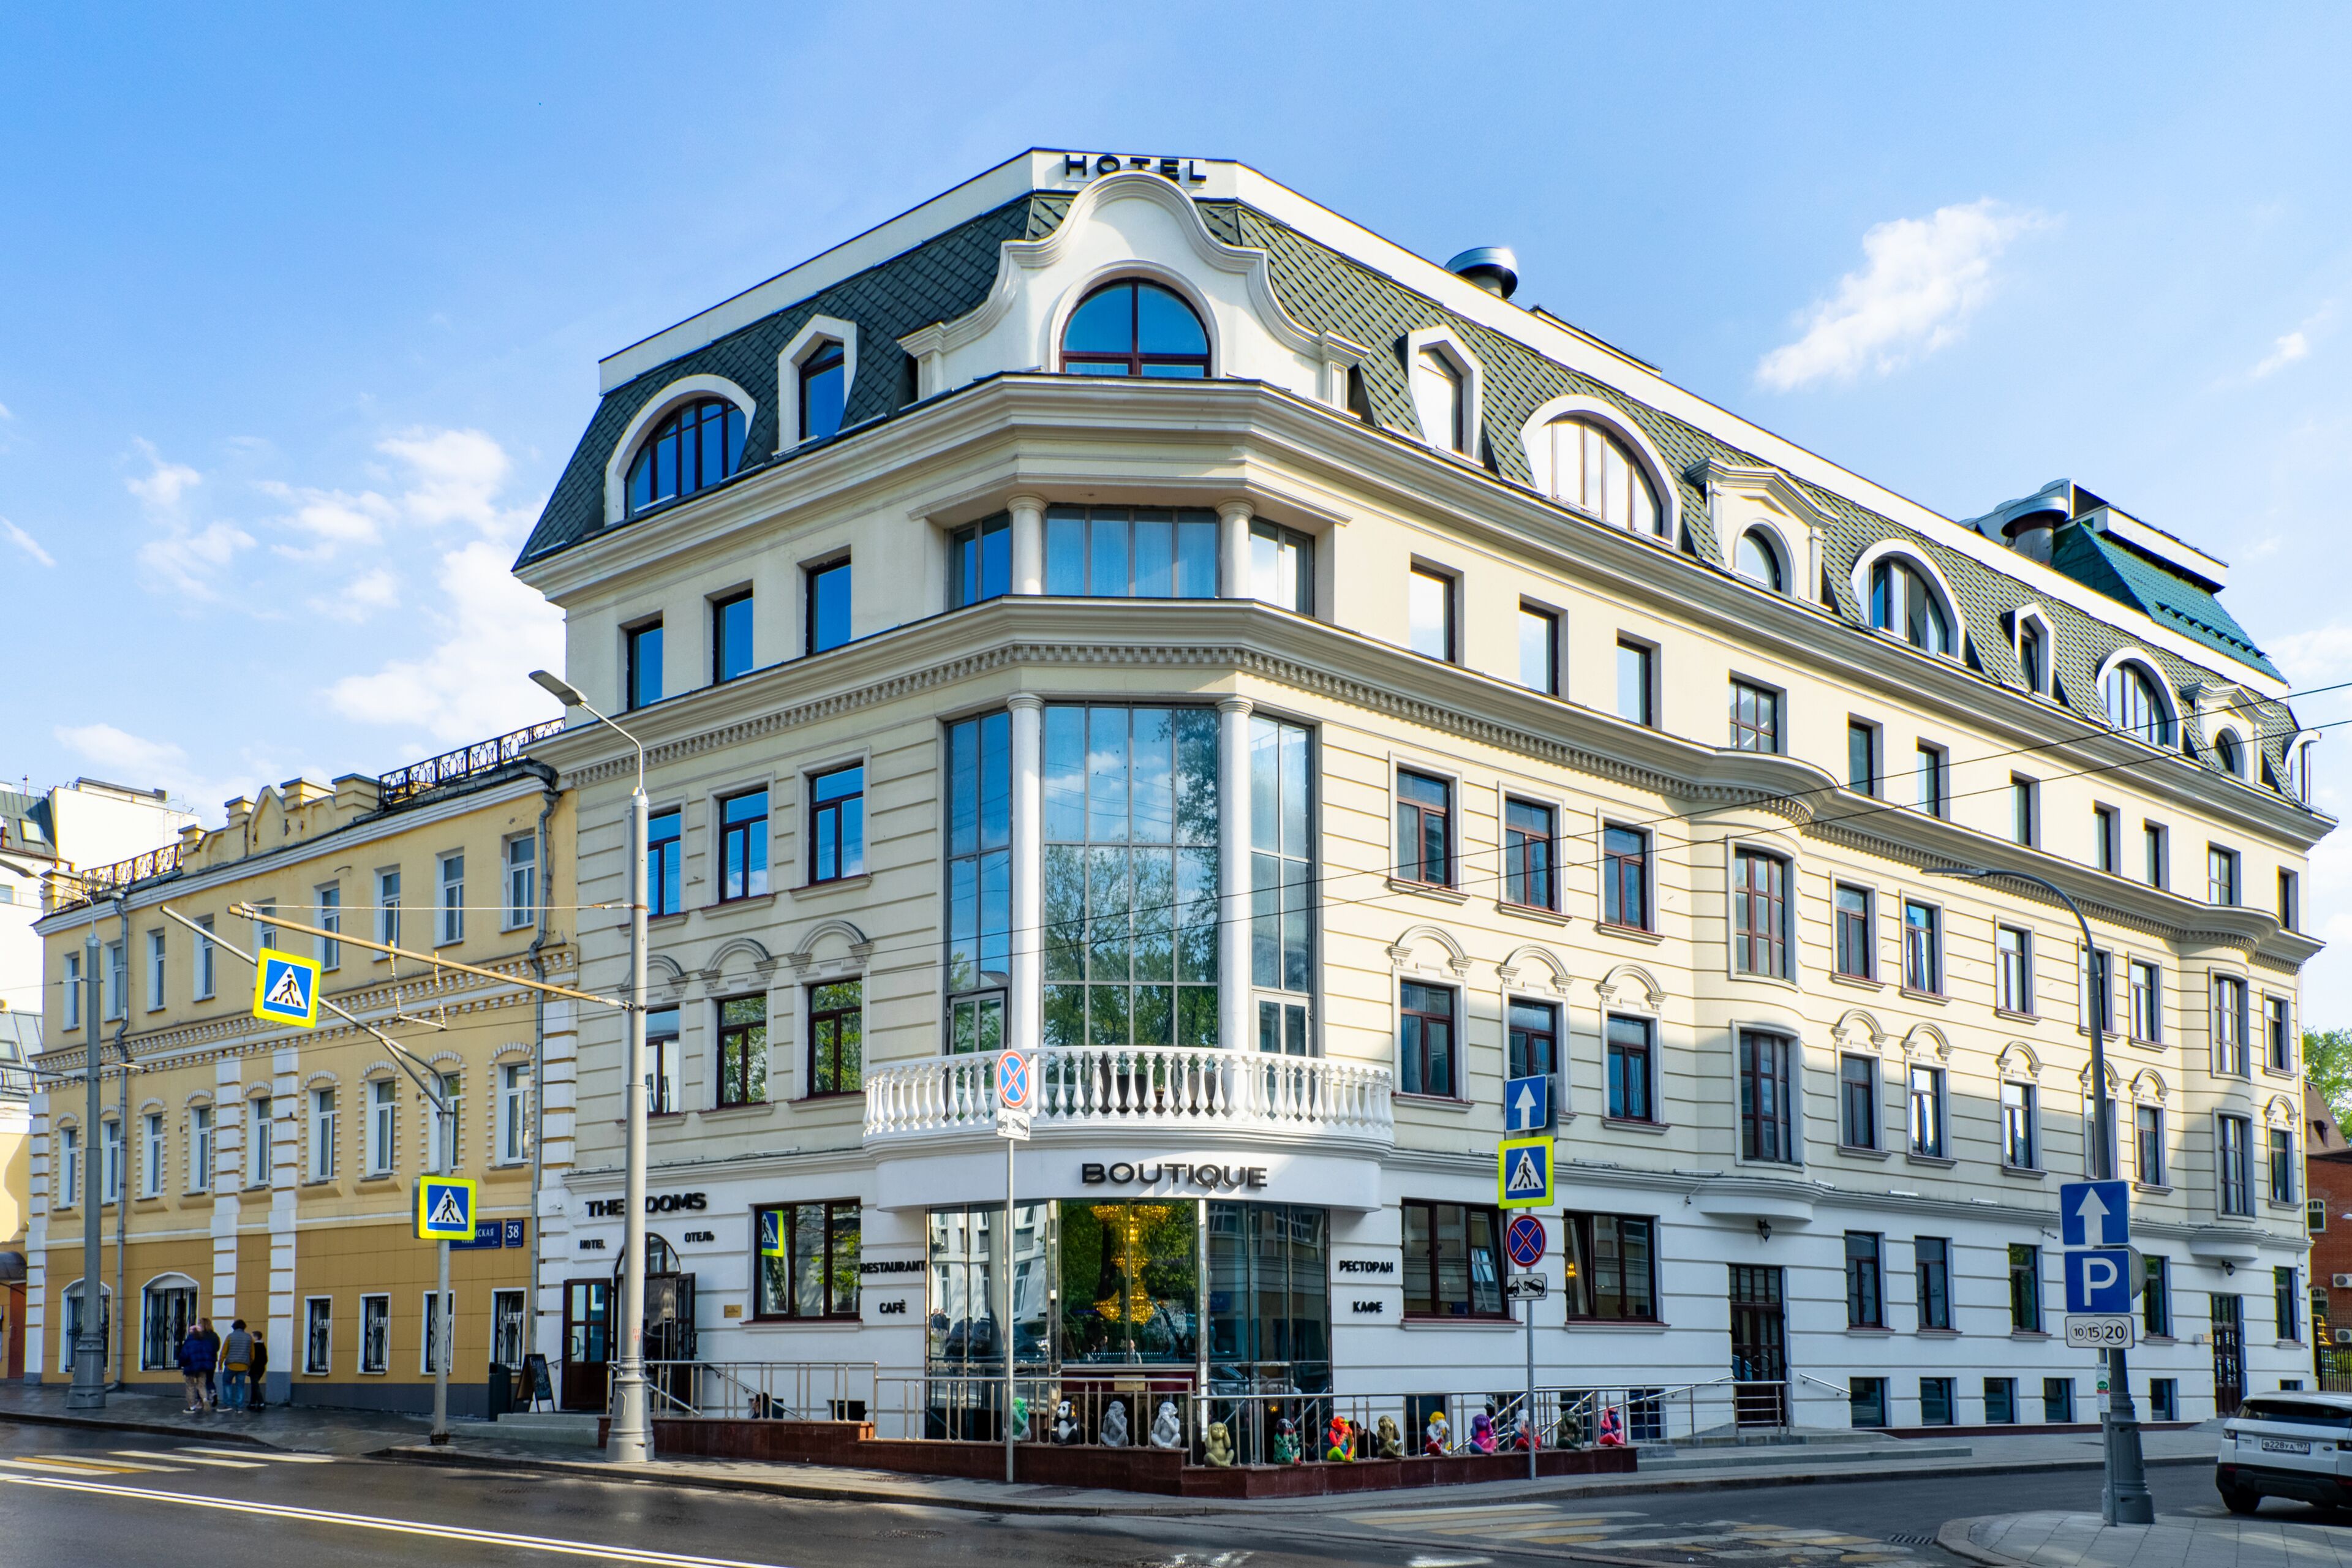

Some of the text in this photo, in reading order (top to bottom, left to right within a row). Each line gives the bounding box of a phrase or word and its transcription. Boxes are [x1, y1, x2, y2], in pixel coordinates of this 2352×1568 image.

[1065, 154, 1207, 181] HOTEL
[1082, 1163, 1267, 1188] BOUTIQUE
[585, 1193, 707, 1217] THE OOMS
[507, 1225, 519, 1238] 38
[684, 1231, 715, 1243] ОТЕЛЬ
[579, 1239, 606, 1250] HOTEL
[860, 1260, 926, 1273] RESTAURANT
[1339, 1260, 1393, 1273] РЕСТОРАН
[2082, 1257, 2118, 1306] P
[1353, 1301, 1383, 1313] КАФЕ
[2074, 1325, 2125, 1339] 10 15 20
